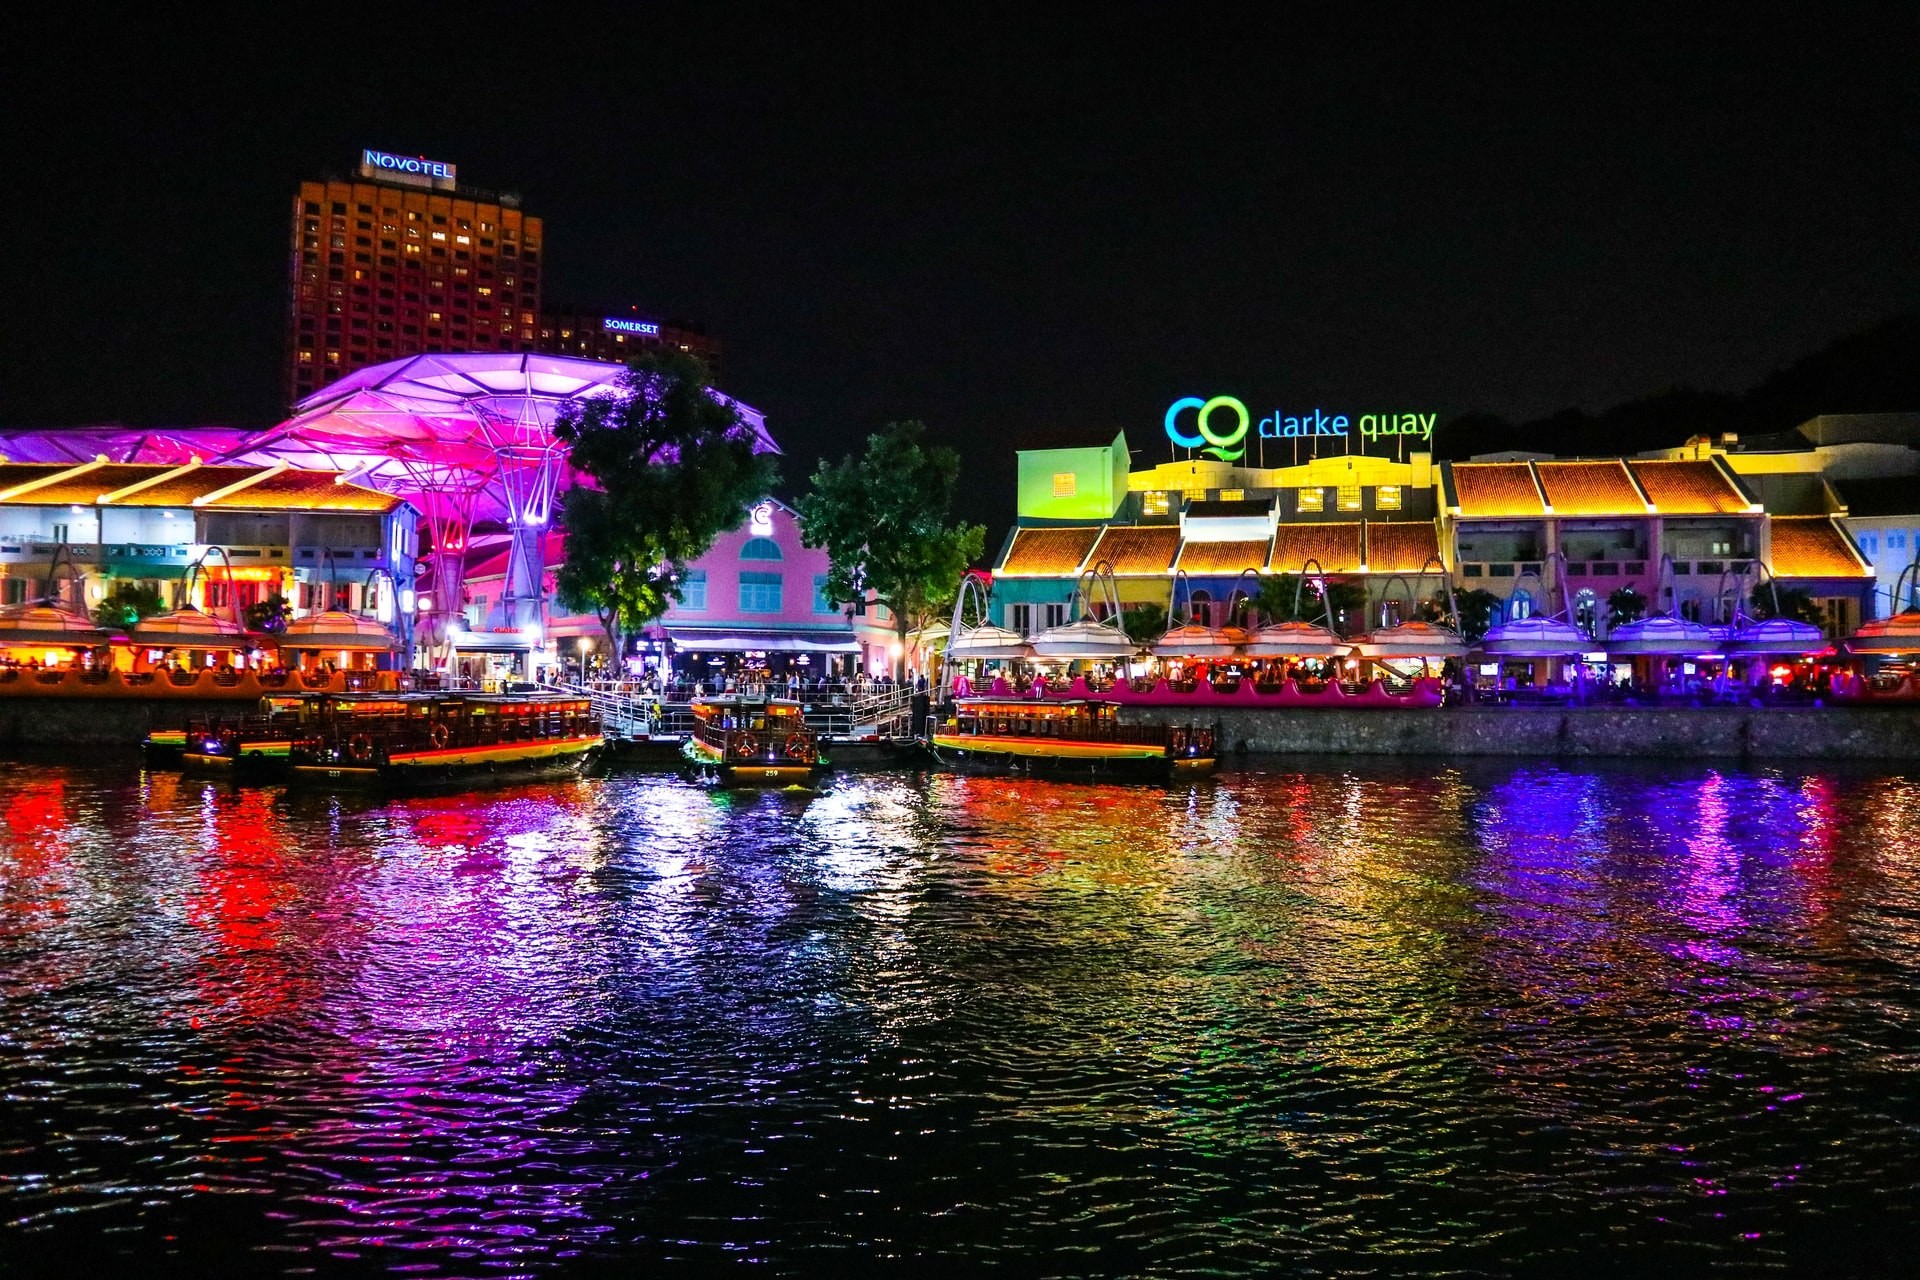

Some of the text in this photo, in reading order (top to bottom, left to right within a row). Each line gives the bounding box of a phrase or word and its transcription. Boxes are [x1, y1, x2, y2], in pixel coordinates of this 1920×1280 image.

[366, 150, 453, 178] NOVOTEL
[605, 319, 658, 334] SOMERSET
[1258, 409, 1437, 442] clarke quay
[765, 769, 779, 777] 259
